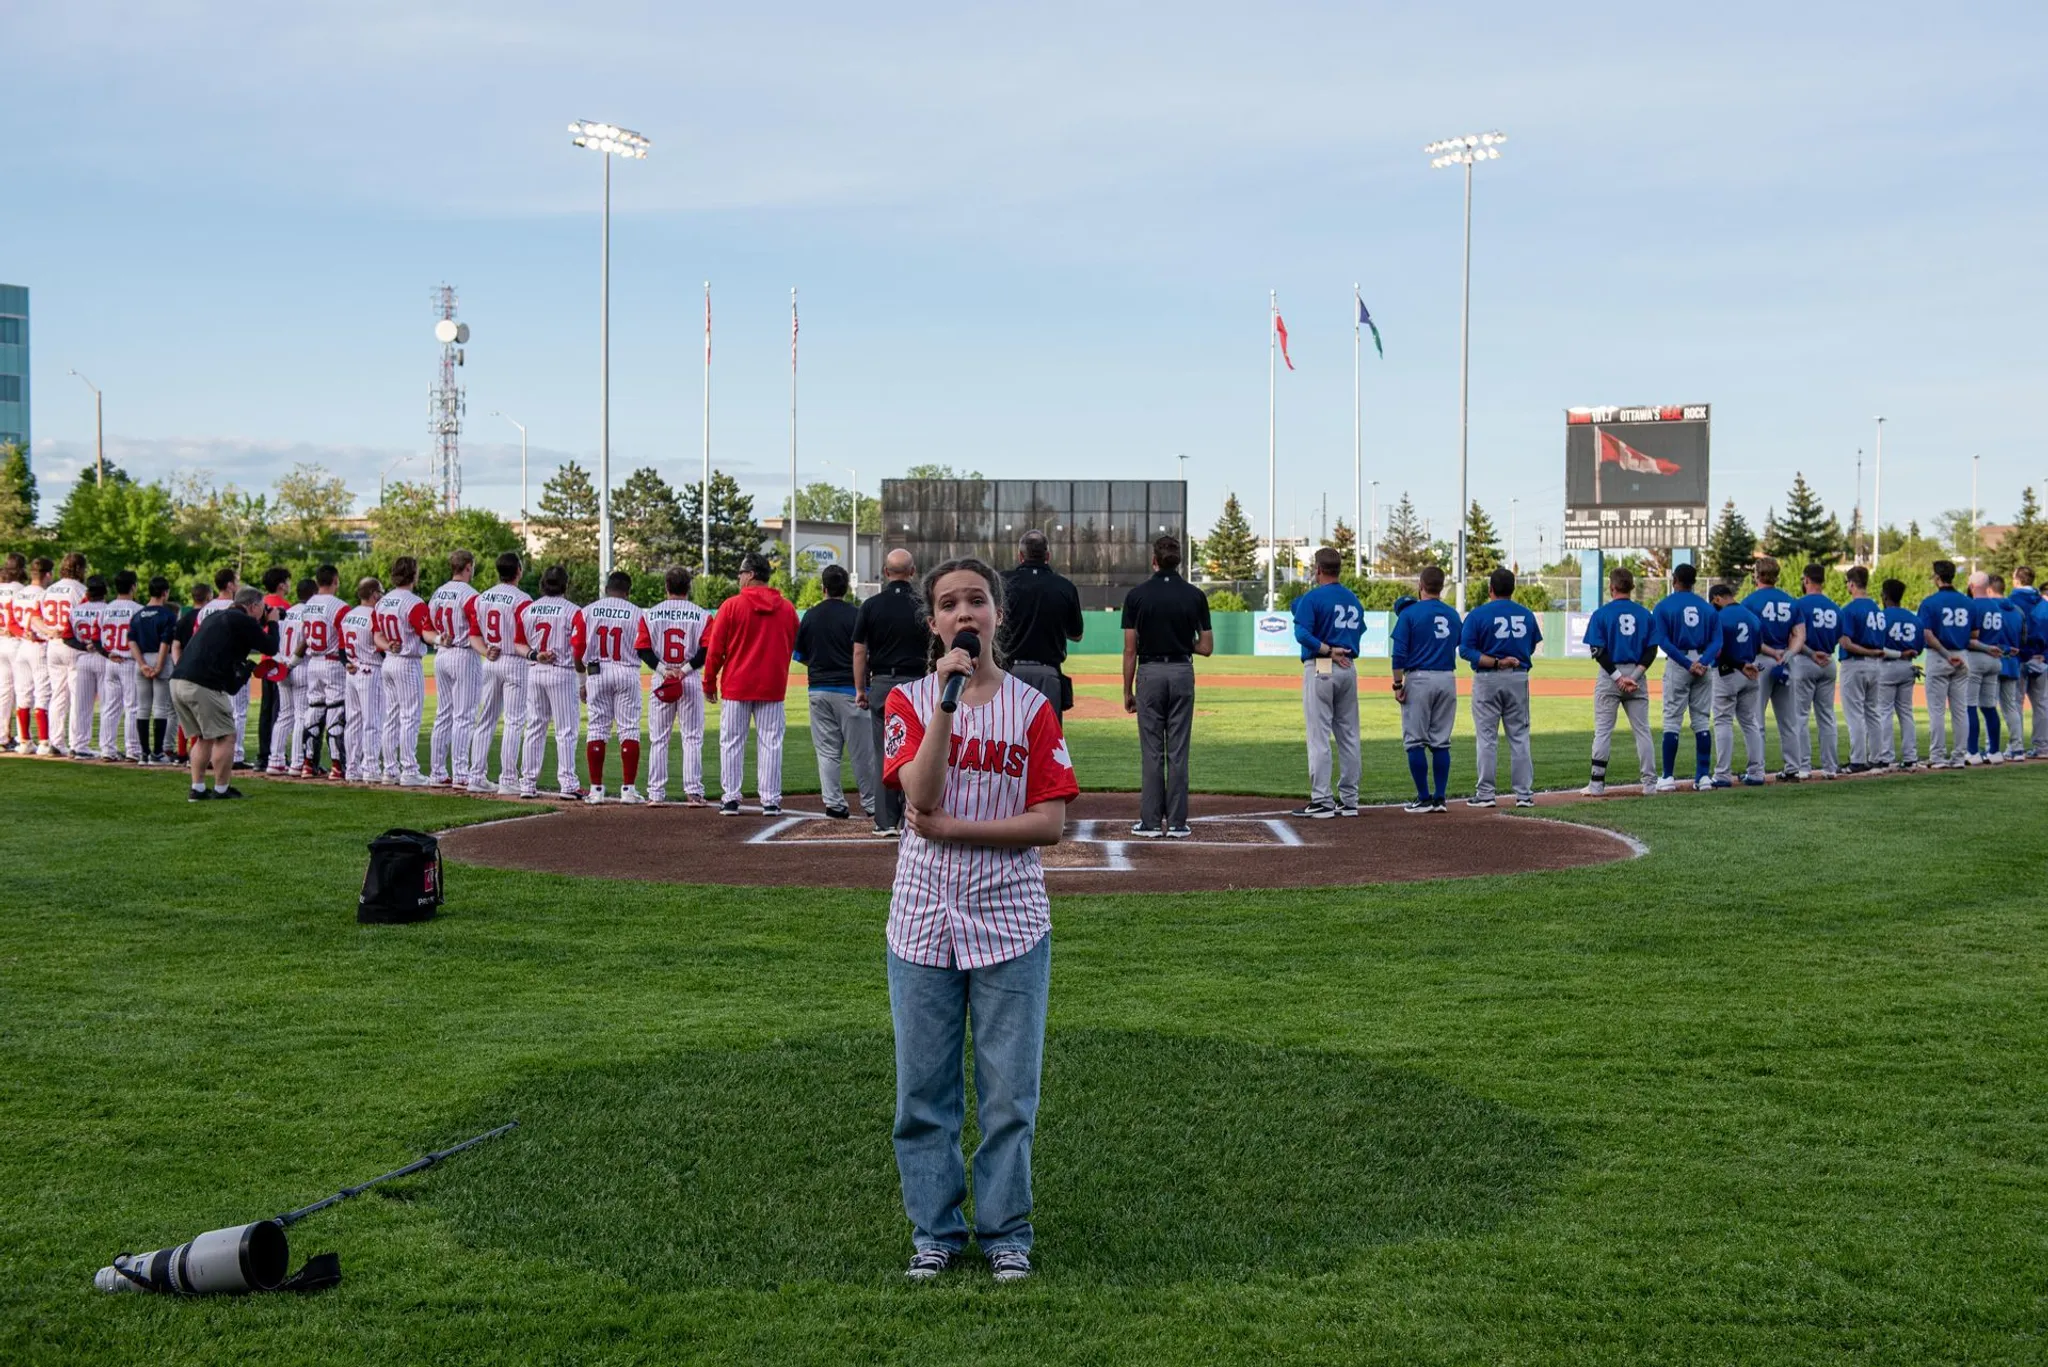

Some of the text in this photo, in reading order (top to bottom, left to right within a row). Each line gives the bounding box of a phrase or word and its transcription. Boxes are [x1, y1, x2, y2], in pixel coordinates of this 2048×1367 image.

[1620, 408, 1660, 422] OTTAWA'S
[1684, 406, 1707, 420] ROCK
[1565, 538, 1599, 549] TITANS
[481, 593, 514, 605] SANFORD
[44, 600, 71, 627] 36
[530, 606, 562, 616] WRIGHT
[592, 607, 631, 620] OROZCO
[649, 609, 701, 622] ZIMMERMAN
[1333, 604, 1360, 630] 22
[1683, 606, 1700, 627] 6
[1761, 601, 1792, 622] 45
[1812, 607, 1838, 629] 39
[1866, 611, 1886, 631] 46
[1942, 607, 1969, 627] 28
[1982, 612, 2003, 631] 66
[486, 609, 502, 643] 9
[1433, 615, 1451, 640] 3
[1493, 615, 1528, 639] 25
[1618, 613, 1636, 636] 8
[1736, 621, 1750, 643] 2
[1888, 621, 1917, 642] 43
[102, 623, 131, 653] 30
[535, 622, 553, 653] 7
[595, 625, 624, 662] 11
[662, 627, 686, 664] 6
[948, 734, 1029, 778] TANS
